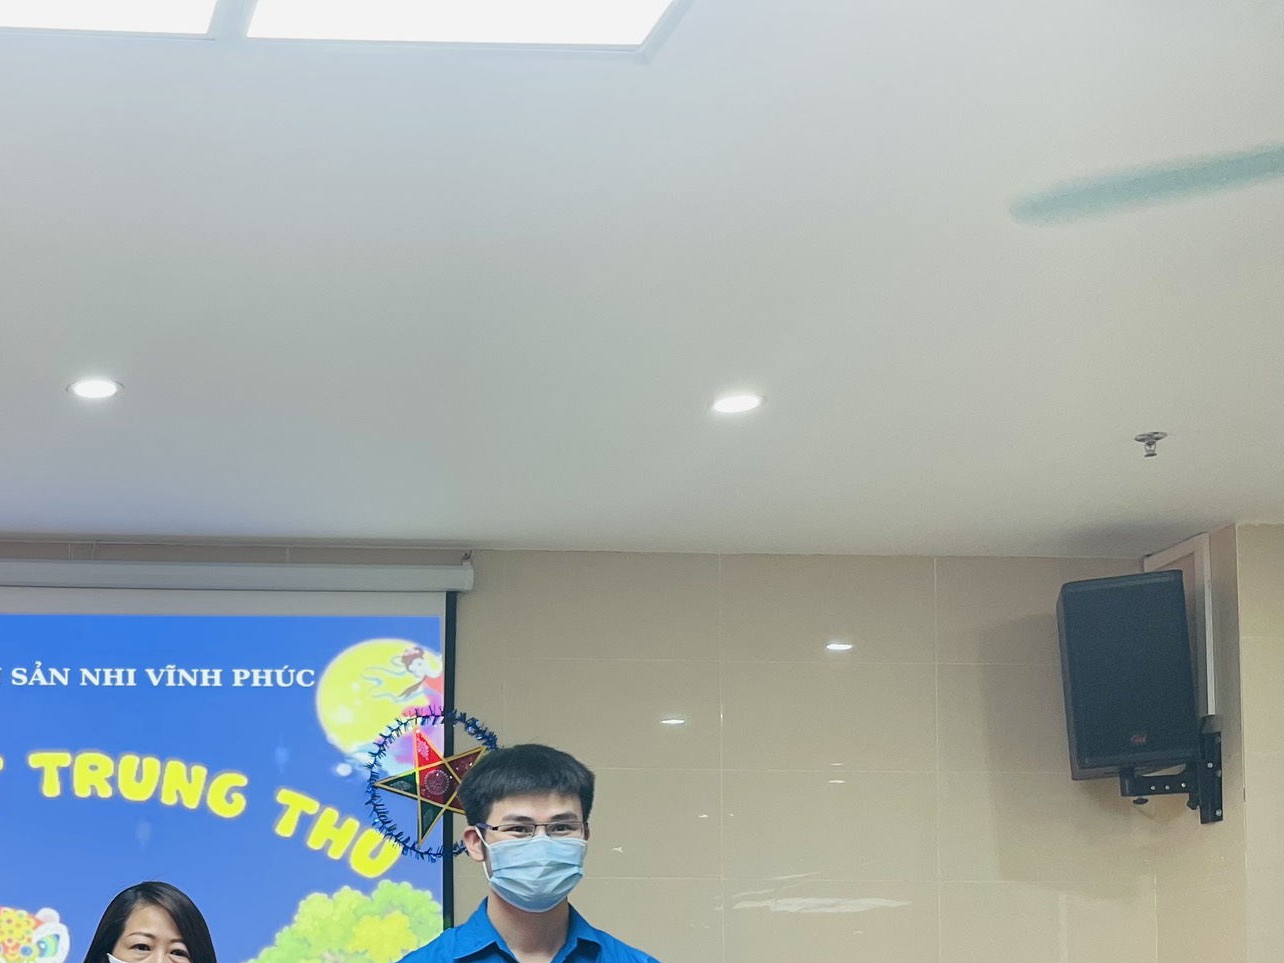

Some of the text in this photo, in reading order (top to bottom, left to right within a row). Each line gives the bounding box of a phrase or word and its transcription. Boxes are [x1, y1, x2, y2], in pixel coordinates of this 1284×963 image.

[11, 660, 71, 687] SẢN
[79, 668, 137, 687] NHI
[145, 664, 223, 687] VĨNH
[232, 664, 316, 688] PHÚC
[27, 751, 249, 818] TRUNG
[273, 787, 402, 878] THU
